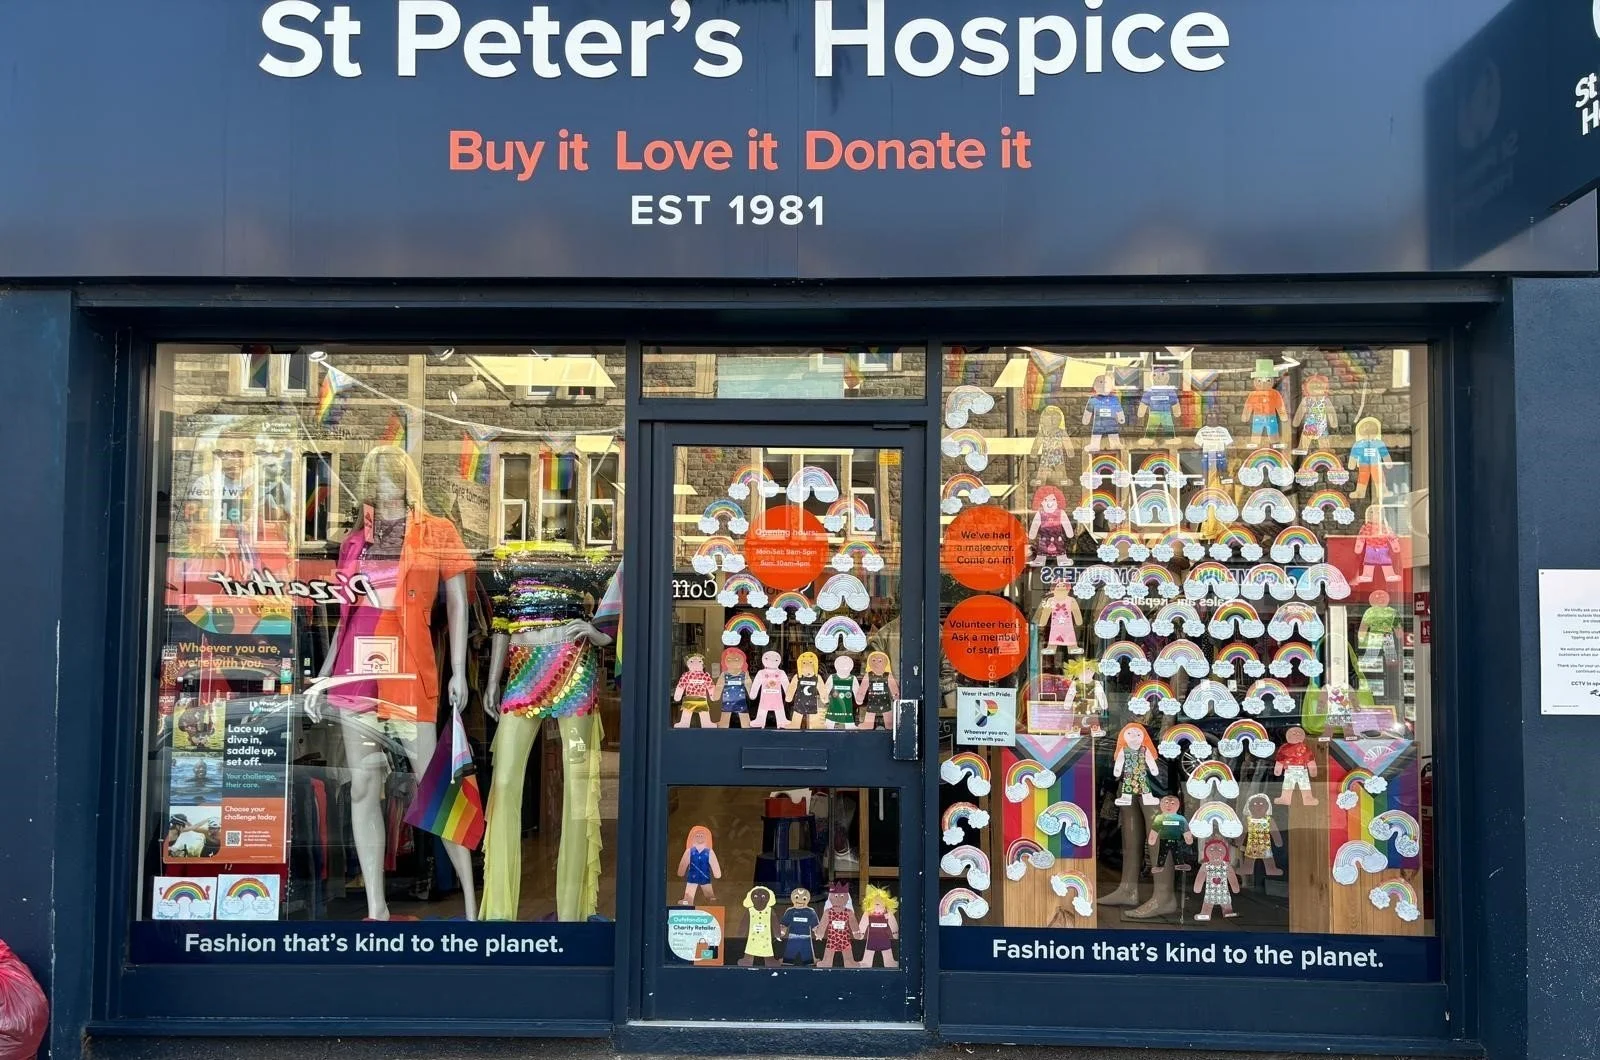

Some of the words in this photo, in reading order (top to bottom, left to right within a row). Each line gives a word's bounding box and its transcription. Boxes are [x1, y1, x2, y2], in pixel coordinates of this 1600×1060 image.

[259, 0, 362, 78] St
[398, 0, 744, 79] Peter’s
[814, 0, 1230, 96] Hospice
[1575, 73, 1598, 108] St
[616, 130, 733, 172] Love
[748, 128, 779, 171] it
[806, 129, 986, 171] Donate
[1001, 126, 1033, 169] it
[448, 130, 546, 181] Buy
[558, 128, 590, 171] it
[631, 195, 711, 226] EST
[729, 195, 825, 226] 1981
[755, 529, 791, 538] Opening
[961, 531, 990, 540] We've
[992, 531, 1011, 540] had
[965, 543, 1014, 551] makeover.
[956, 556, 985, 564] Come
[1002, 556, 1014, 565] in!
[949, 620, 995, 629] Volunteer
[951, 633, 969, 641] Ask
[980, 633, 1020, 642] member
[179, 642, 232, 654] Whoever
[235, 645, 256, 657] you
[258, 645, 281, 656] are,
[966, 645, 978, 654] of
[979, 645, 1002, 655] staff.
[178, 659, 210, 669] we're
[211, 658, 239, 668] with
[240, 660, 265, 670] you.
[228, 724, 252, 733] Lace
[253, 726, 269, 735] up,
[227, 735, 249, 744] dive
[250, 735, 263, 745] in,
[226, 746, 260, 755] saddle
[261, 748, 277, 758] up,
[226, 757, 242, 766] set
[243, 757, 262, 766] off.
[242, 772, 277, 781] challenge,
[224, 805, 250, 813] Choose
[224, 813, 257, 822] challenge
[257, 814, 277, 822] today
[185, 932, 276, 952] Fashion
[283, 932, 348, 952] that’s
[355, 933, 404, 952] kind
[411, 935, 435, 952] to
[440, 934, 479, 953] the
[485, 934, 564, 957] planet.
[992, 939, 1085, 960] Fashion
[1092, 940, 1159, 962] that’s
[1166, 942, 1217, 963] kind
[1223, 944, 1248, 964] to
[1254, 944, 1294, 965] the
[1301, 945, 1384, 970] planet.
